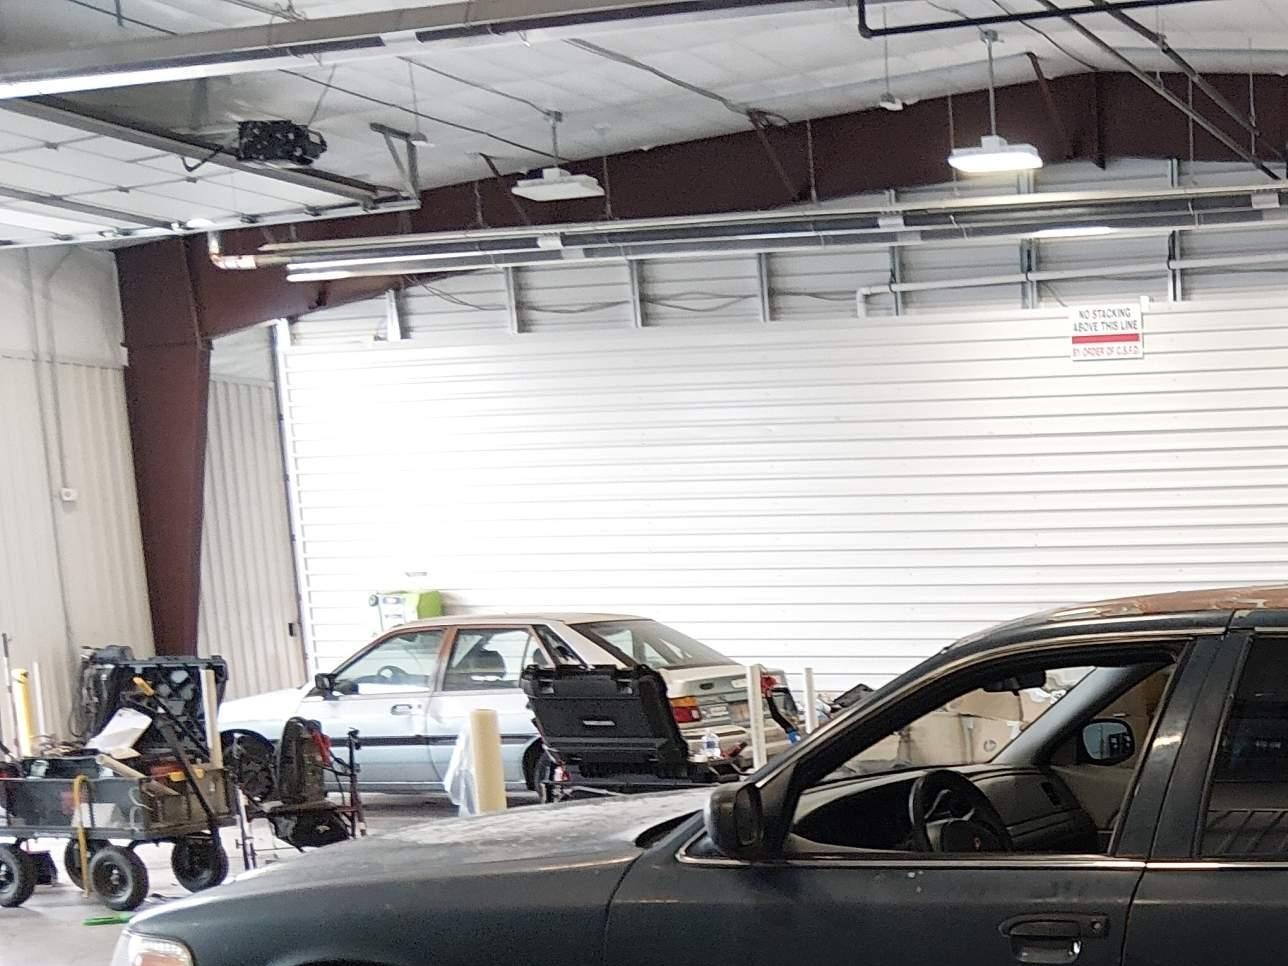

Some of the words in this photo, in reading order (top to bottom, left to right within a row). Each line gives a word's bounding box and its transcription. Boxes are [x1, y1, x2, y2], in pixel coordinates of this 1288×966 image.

[1079, 309, 1089, 320] NO
[1092, 307, 1131, 319] STACKING
[1073, 321, 1099, 332] ABOVE
[1101, 320, 1119, 331] THIS
[1120, 319, 1138, 330] LINE
